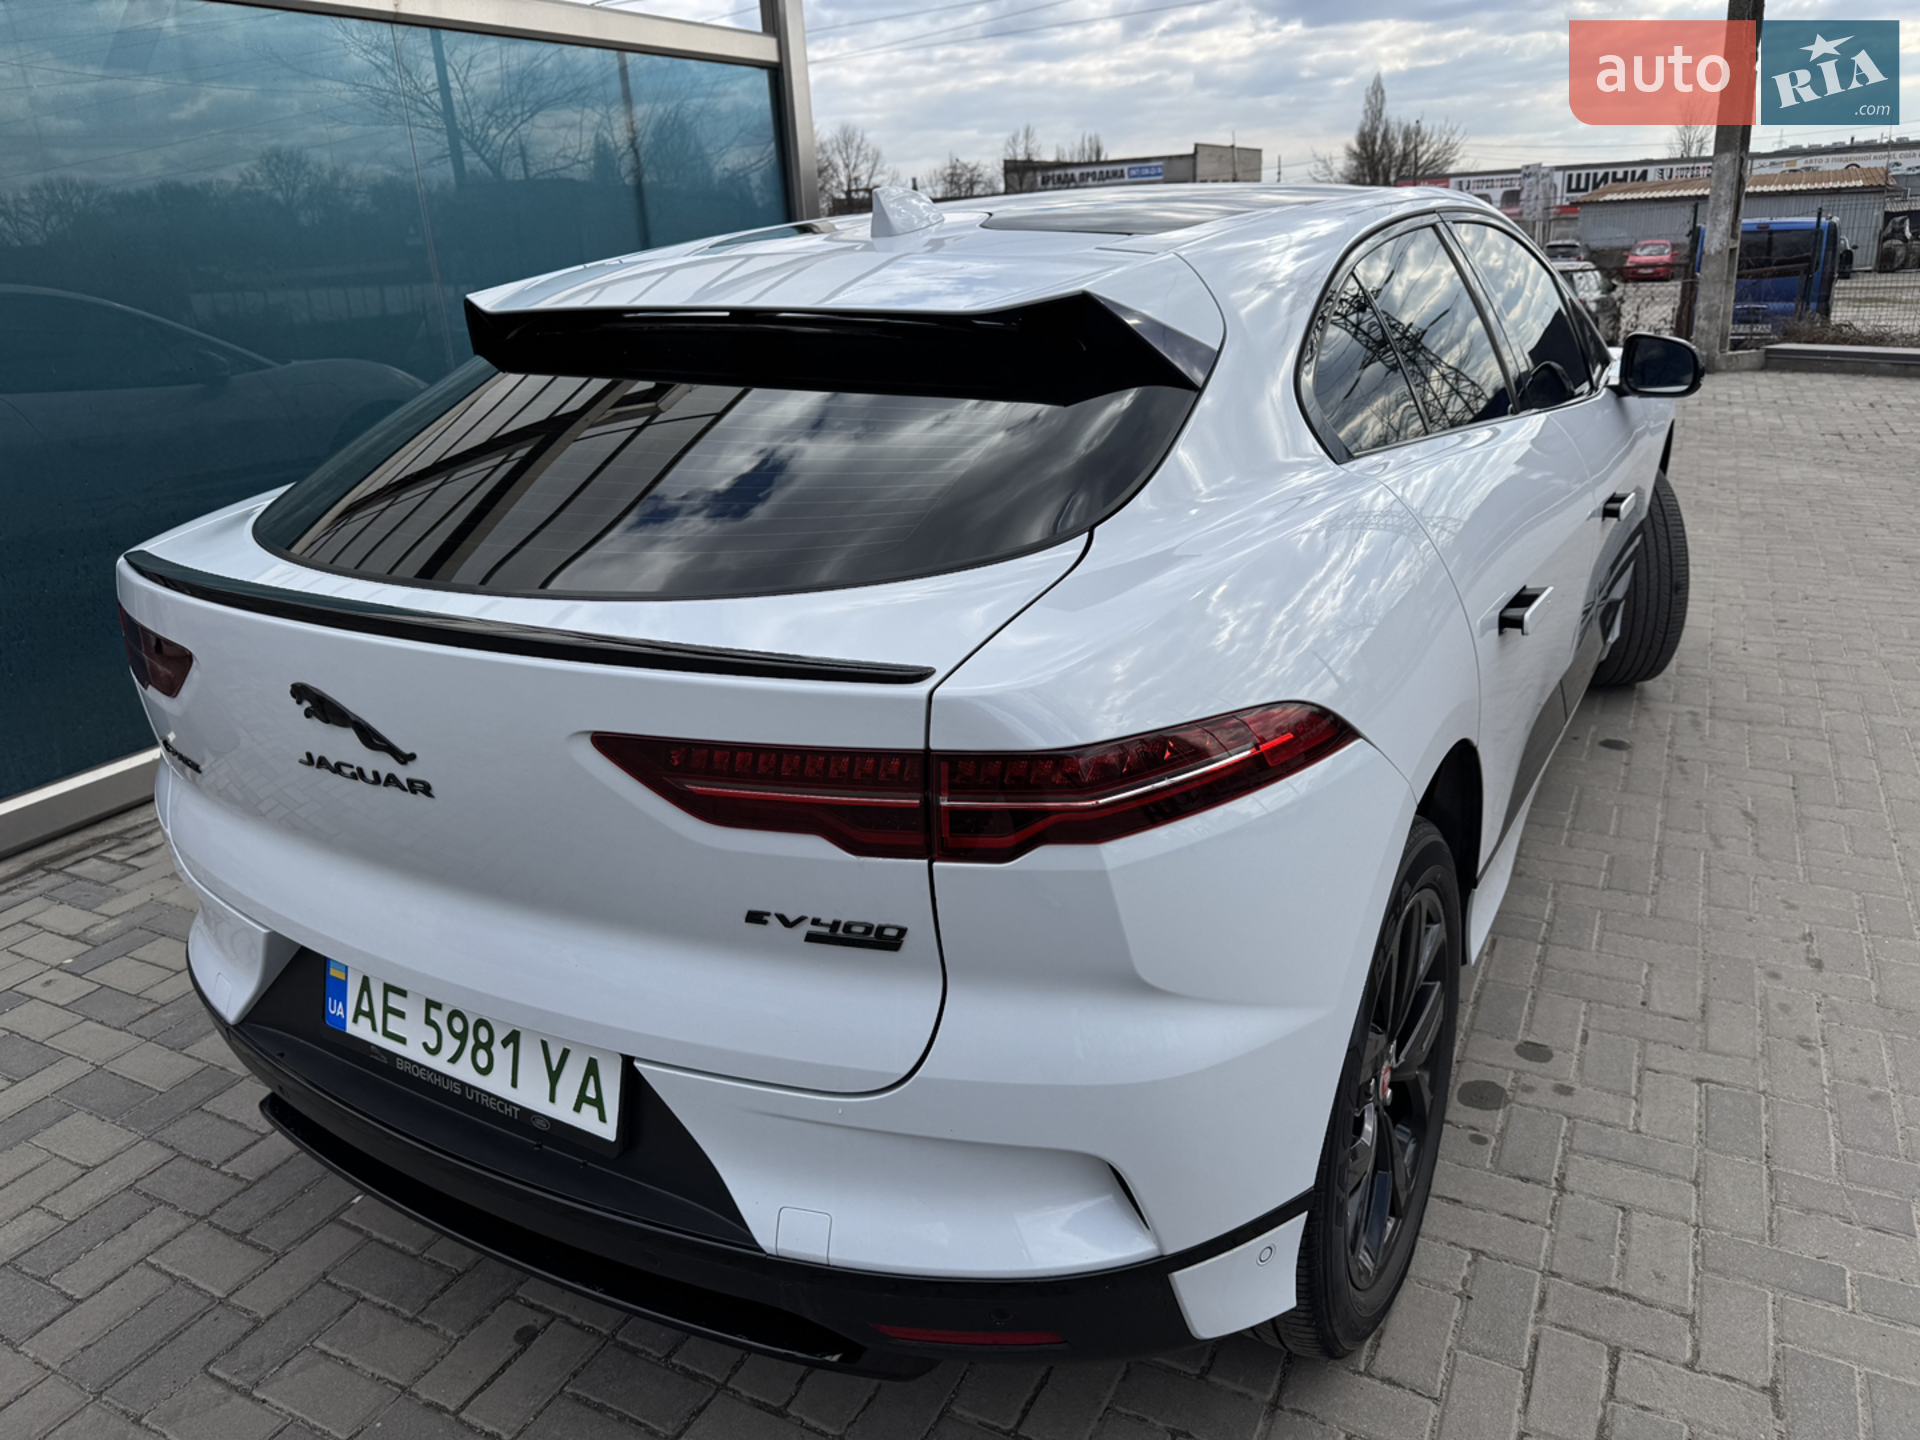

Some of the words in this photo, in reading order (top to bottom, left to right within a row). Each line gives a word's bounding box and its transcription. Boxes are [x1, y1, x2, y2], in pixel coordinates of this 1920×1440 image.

[299, 751, 435, 799] JAGUAR
[744, 909, 908, 940] EV400
[328, 996, 345, 1020] UA
[352, 974, 408, 1046] AE
[422, 997, 521, 1080] 5981
[540, 1038, 608, 1124] YA
[395, 1056, 462, 1096] BROEKHUIS
[465, 1086, 521, 1120] UTRECHT
